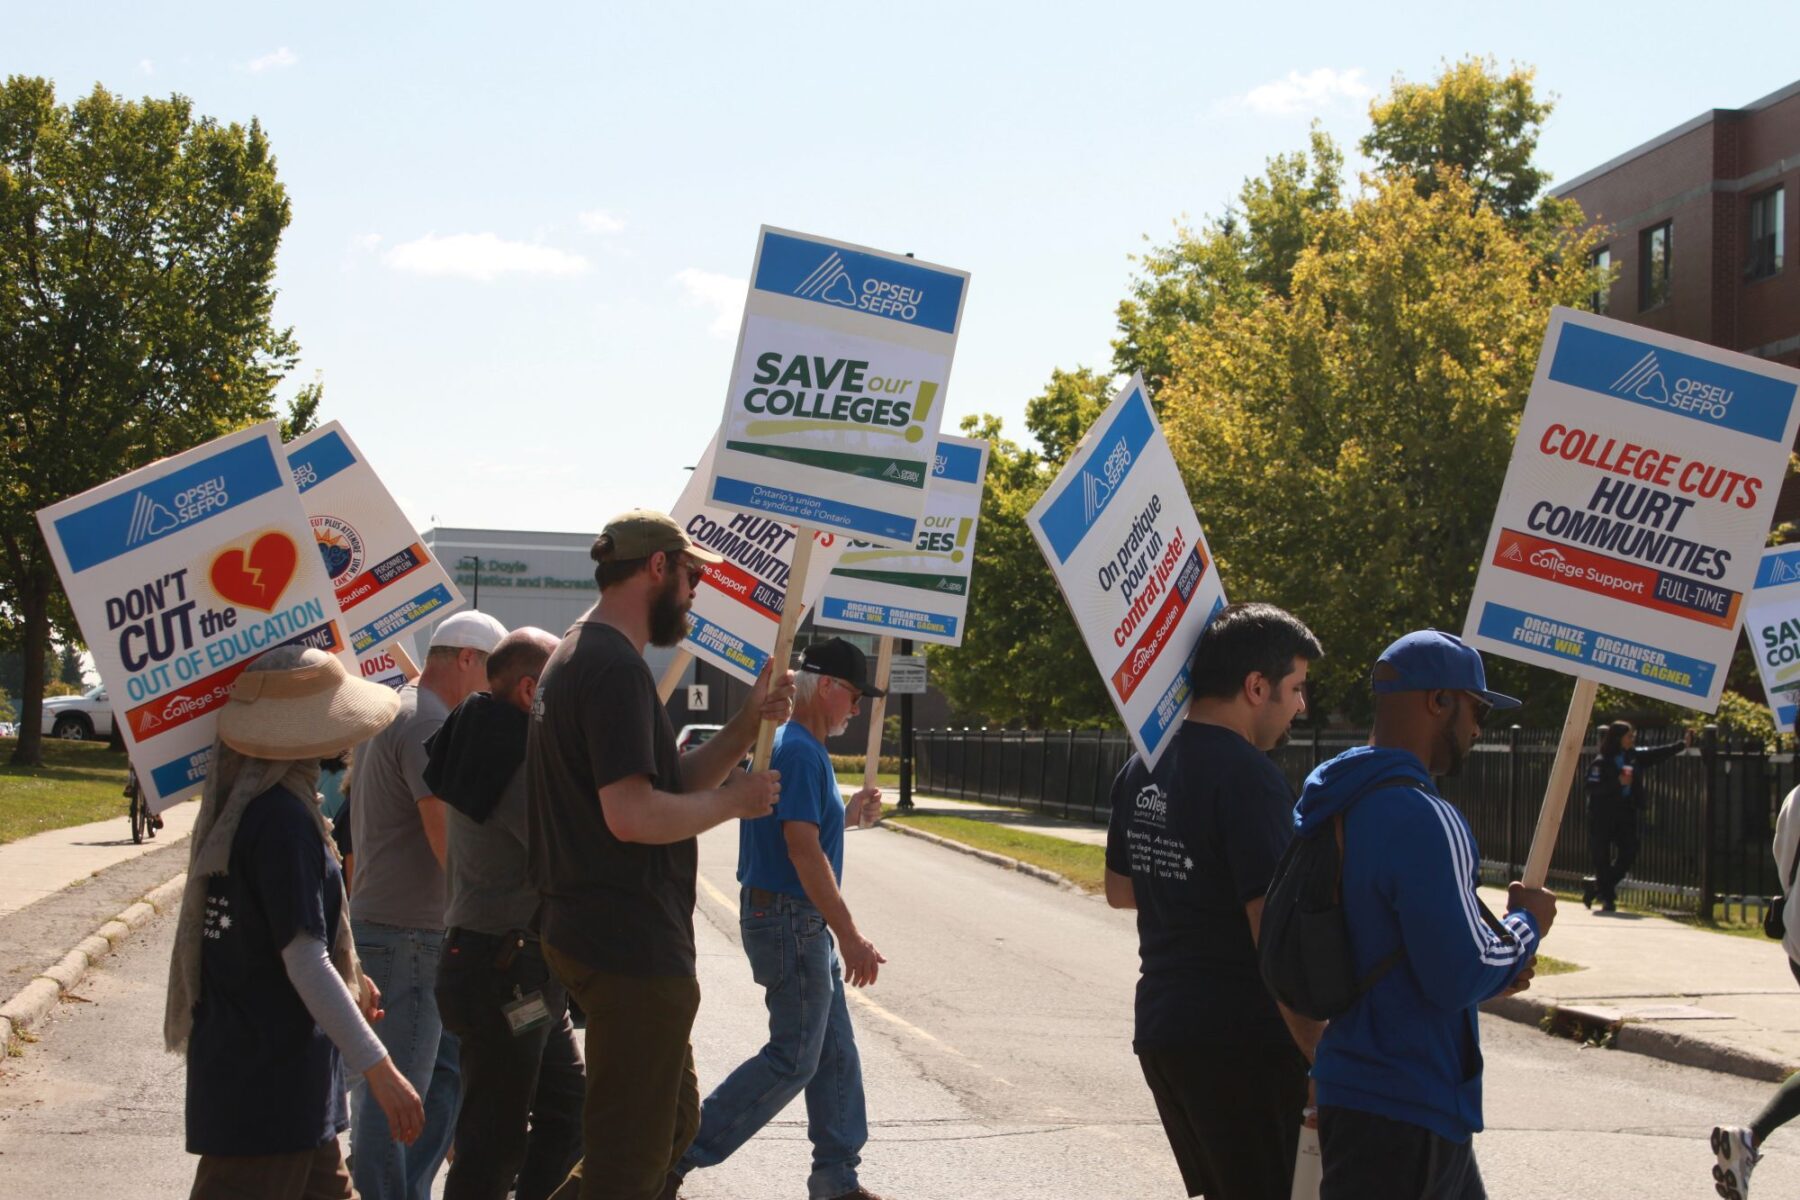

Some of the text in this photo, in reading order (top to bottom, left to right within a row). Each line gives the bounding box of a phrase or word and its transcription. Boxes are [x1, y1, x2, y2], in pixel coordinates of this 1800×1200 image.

[858, 293, 917, 321] SEFPO
[862, 278, 922, 305] OPSEU
[753, 352, 913, 395] SAVE our
[1674, 378, 1734, 405] OPSEU
[1669, 392, 1726, 419] SEFPO
[292, 461, 312, 481] SEU
[1103, 435, 1127, 475] OPSEU
[1108, 450, 1131, 490] SEFPO
[1539, 423, 1763, 509] COLLEGE CUTS
[174, 476, 226, 508] OPSEU
[178, 491, 228, 524] SEFPO
[750, 495, 851, 526] Le syndicat de l'Ontario
[753, 486, 821, 509] Ontario's union
[1587, 476, 1696, 533] HURT
[310, 518, 362, 553] EUT PLUS ATTENDRE
[728, 513, 796, 554] HURT
[924, 515, 956, 529] our
[1527, 501, 1732, 581] COMMUNITIES
[686, 514, 792, 589] COMMUNITIE
[1098, 494, 1162, 592] On pratique
[1113, 525, 1186, 647] contrat juste!
[1120, 530, 1164, 605] pour un
[1529, 551, 1727, 613] College Support FULL-TIME
[105, 568, 188, 631] DON'T
[338, 584, 372, 607] Soutien
[712, 569, 747, 595] Support
[754, 585, 786, 614] FULL-TI
[373, 601, 420, 631] ORGANISER.
[378, 617, 410, 638] LUTTER.
[407, 598, 442, 620] GAGNER.
[842, 609, 865, 620] FIGHT.
[888, 617, 916, 628] LUTTER.
[847, 602, 885, 615] ORGANIZE.
[889, 609, 931, 622] ORGANISER.
[1155, 605, 1179, 643] Soutien
[119, 599, 238, 674] CUT the
[127, 663, 172, 701] OUT
[175, 650, 204, 681] OF
[206, 597, 325, 668] EDUCATION
[697, 631, 725, 655] LUTTER.
[725, 647, 756, 671] GAGNER.
[702, 623, 744, 653] ORGANISER.
[1523, 616, 1668, 668] ORGANIZE. ORGANISER.
[1512, 627, 1552, 650] FIGHT.
[1554, 638, 1583, 658] WIN.
[1591, 648, 1639, 673] LUTTER.
[1641, 662, 1693, 688] GAGNER.
[162, 693, 212, 722] College
